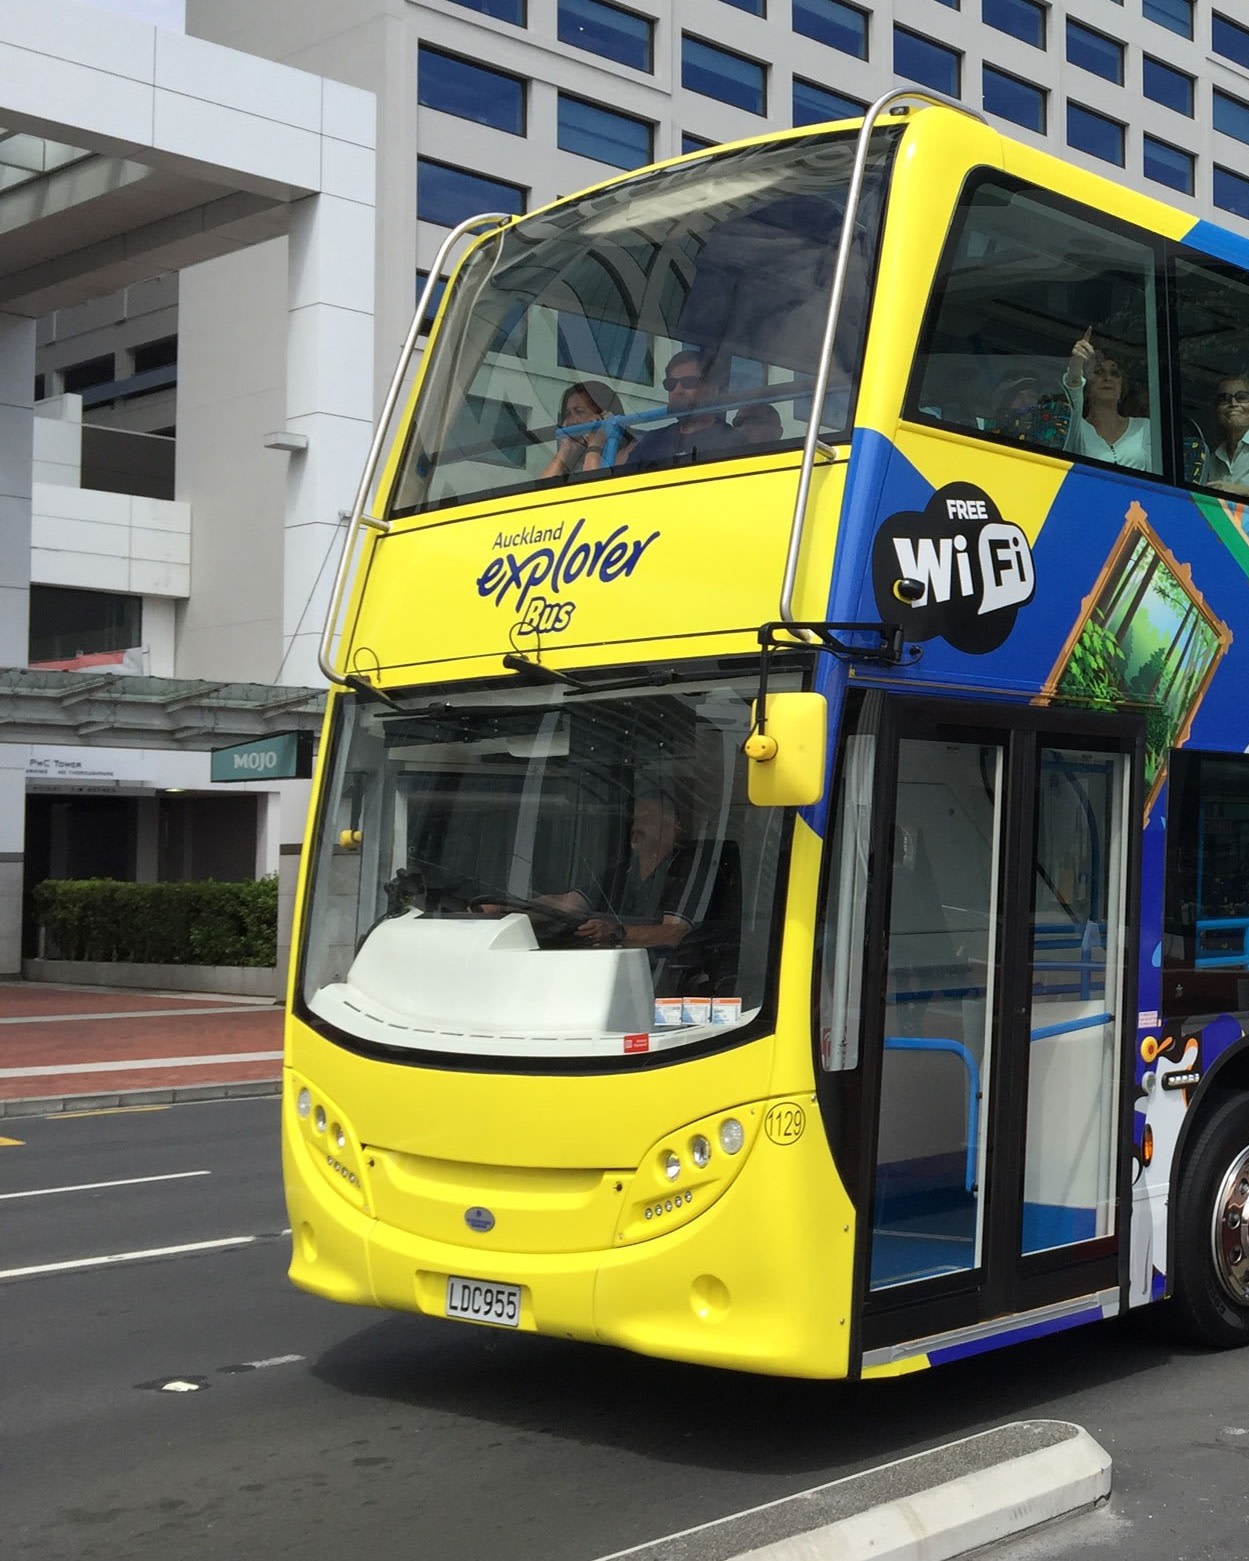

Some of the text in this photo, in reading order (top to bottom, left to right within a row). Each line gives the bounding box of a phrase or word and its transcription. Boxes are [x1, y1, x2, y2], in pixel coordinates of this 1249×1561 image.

[946, 499, 989, 520] FREE
[491, 520, 565, 550] Auckland
[476, 518, 661, 613] explorer
[517, 596, 577, 636] Bus
[233, 751, 277, 771] MOJO
[768, 1110, 802, 1137] 1129
[449, 1282, 517, 1320] LDC955
